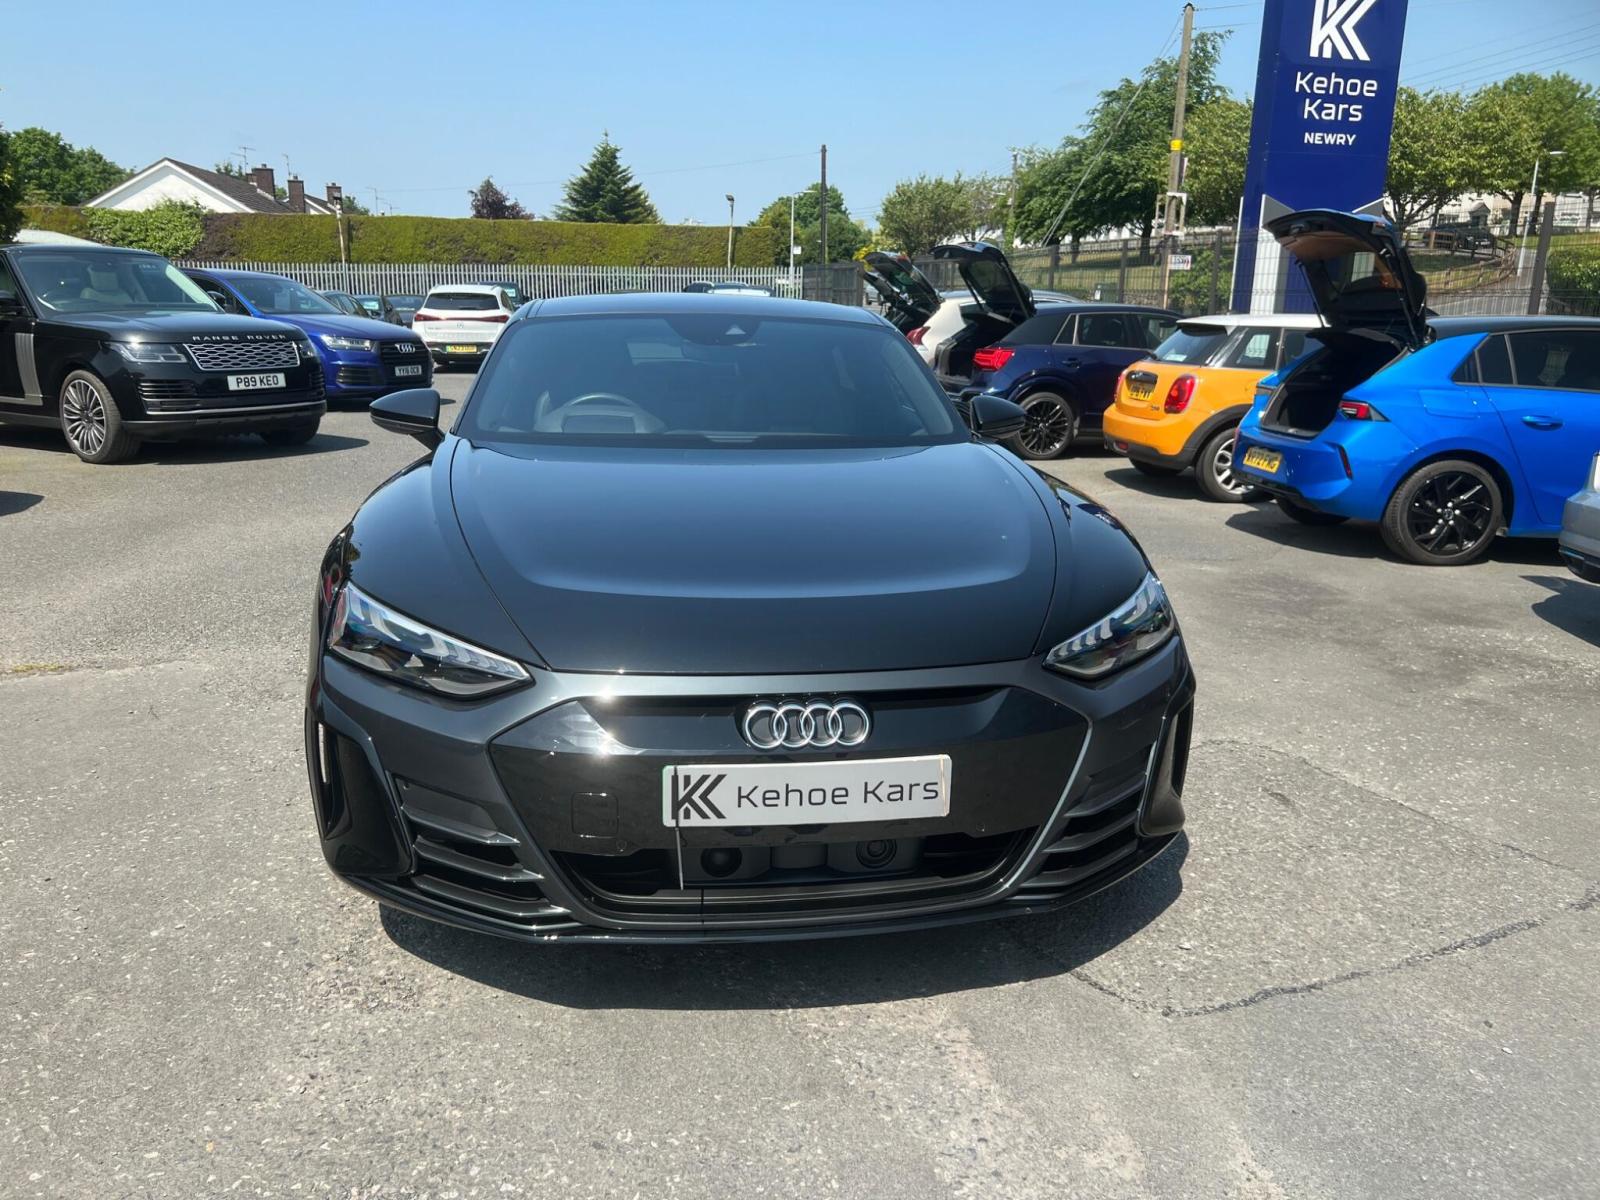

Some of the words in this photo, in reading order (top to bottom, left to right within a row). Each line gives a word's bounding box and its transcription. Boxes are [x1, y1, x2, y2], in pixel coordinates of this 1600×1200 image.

[1295, 71, 1378, 97] Kehoe
[1303, 98, 1363, 122] Kars
[1304, 132, 1356, 146] NEWRY
[236, 376, 257, 388] P89
[259, 375, 279, 387] KEO
[737, 783, 849, 808] Kehoe
[863, 780, 939, 804] Kars
